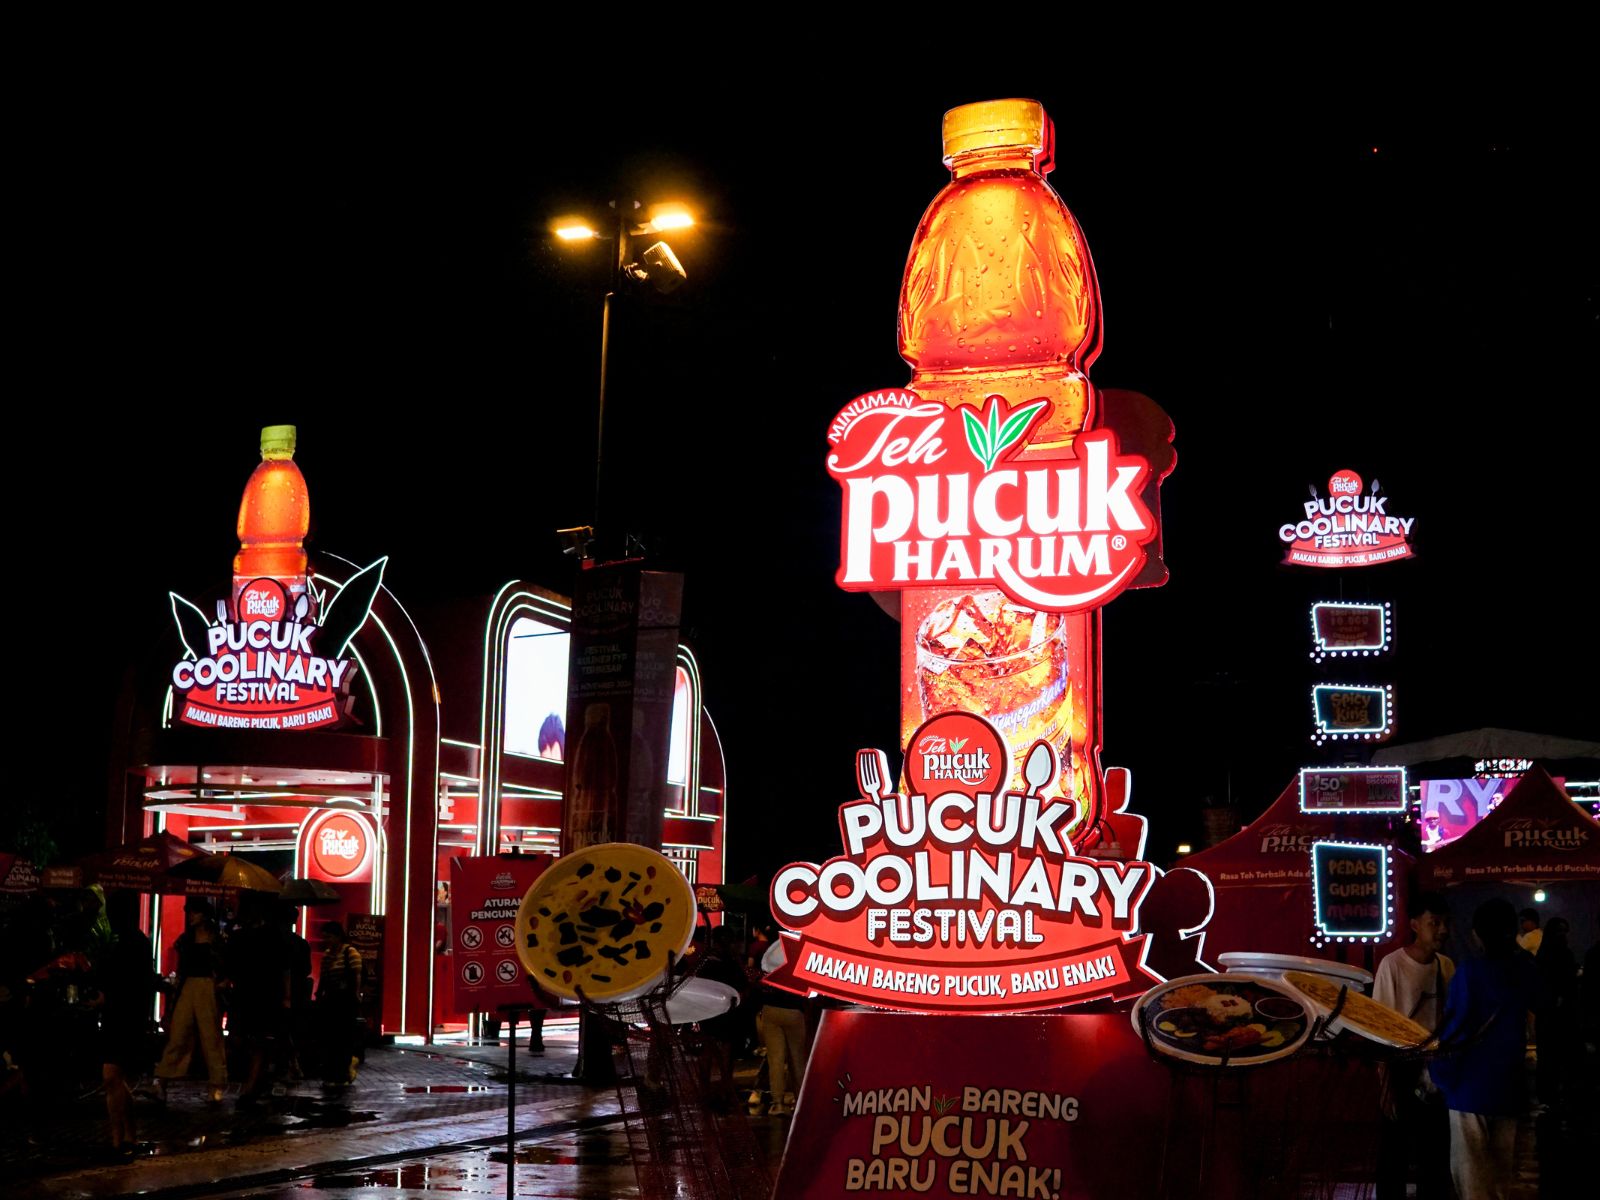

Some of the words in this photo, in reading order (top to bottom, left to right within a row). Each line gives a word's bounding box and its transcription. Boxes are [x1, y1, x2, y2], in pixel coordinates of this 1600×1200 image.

[827, 392, 914, 444] MINUMAN
[827, 403, 948, 473] Teh
[843, 439, 1146, 583] pucuk
[1304, 495, 1388, 519] PUCUK
[1279, 514, 1415, 542] COOLINARY
[1314, 532, 1380, 548] FESTIVAL
[208, 620, 316, 655] PUCUK
[173, 651, 348, 689] COOLINARY
[216, 682, 299, 701] FESTIVAL
[186, 706, 217, 724] MAKAN
[217, 715, 250, 728] BARENG
[282, 714, 306, 728] BARU
[307, 706, 332, 723] ENAK!
[919, 738, 946, 754] Teh
[923, 748, 991, 779] pucuk
[844, 793, 1072, 855] PUCUK
[1504, 826, 1590, 848] pucuk
[774, 850, 1150, 919] COOLINARY
[1327, 859, 1377, 876] PEDAS
[1328, 882, 1377, 898] GURIH
[867, 909, 1044, 943] FESTIVAL
[805, 951, 870, 987] MAKAN
[871, 969, 940, 995] BARENG
[944, 974, 1006, 998] PUCUK,
[1011, 965, 1061, 991] BARU
[1063, 956, 1117, 987] ENAK!
[842, 1086, 932, 1117] MAKAN
[961, 1086, 1080, 1122] BARENG
[872, 1115, 1030, 1162] PUCUK
[846, 1158, 936, 1192] BARU
[949, 1160, 1062, 1200] ENAK!
